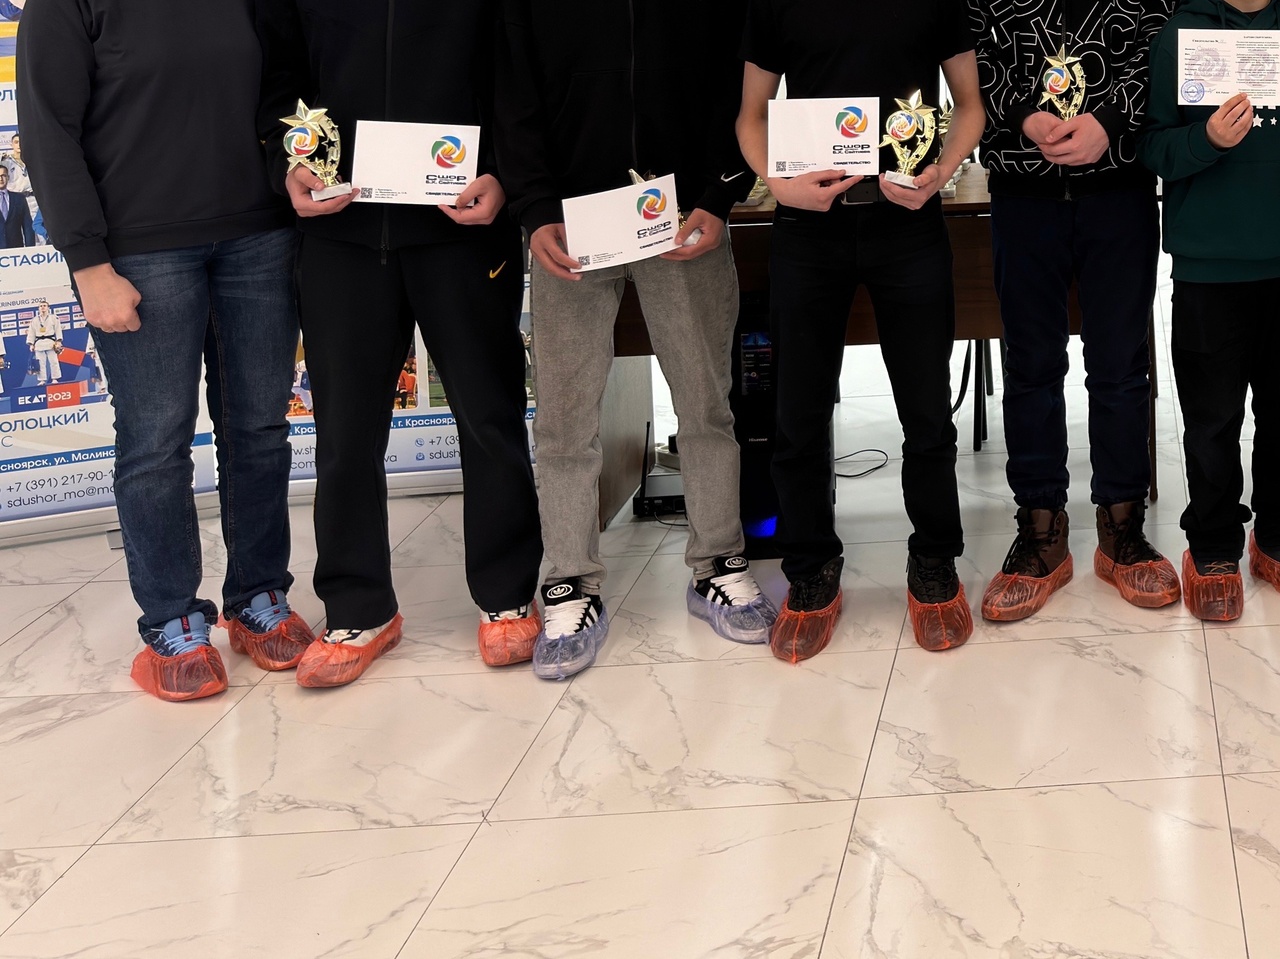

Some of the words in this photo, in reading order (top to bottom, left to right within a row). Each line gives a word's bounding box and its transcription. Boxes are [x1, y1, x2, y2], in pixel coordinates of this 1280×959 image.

[18, 394, 47, 405] EKAT
[48, 391, 72, 402] 2023
[0, 408, 89, 433] ОЛОЦКИЙ
[429, 436, 442, 446] +7
[54, 456, 69, 466] ул.
[7, 482, 23, 493] +7
[25, 477, 58, 493] (391)
